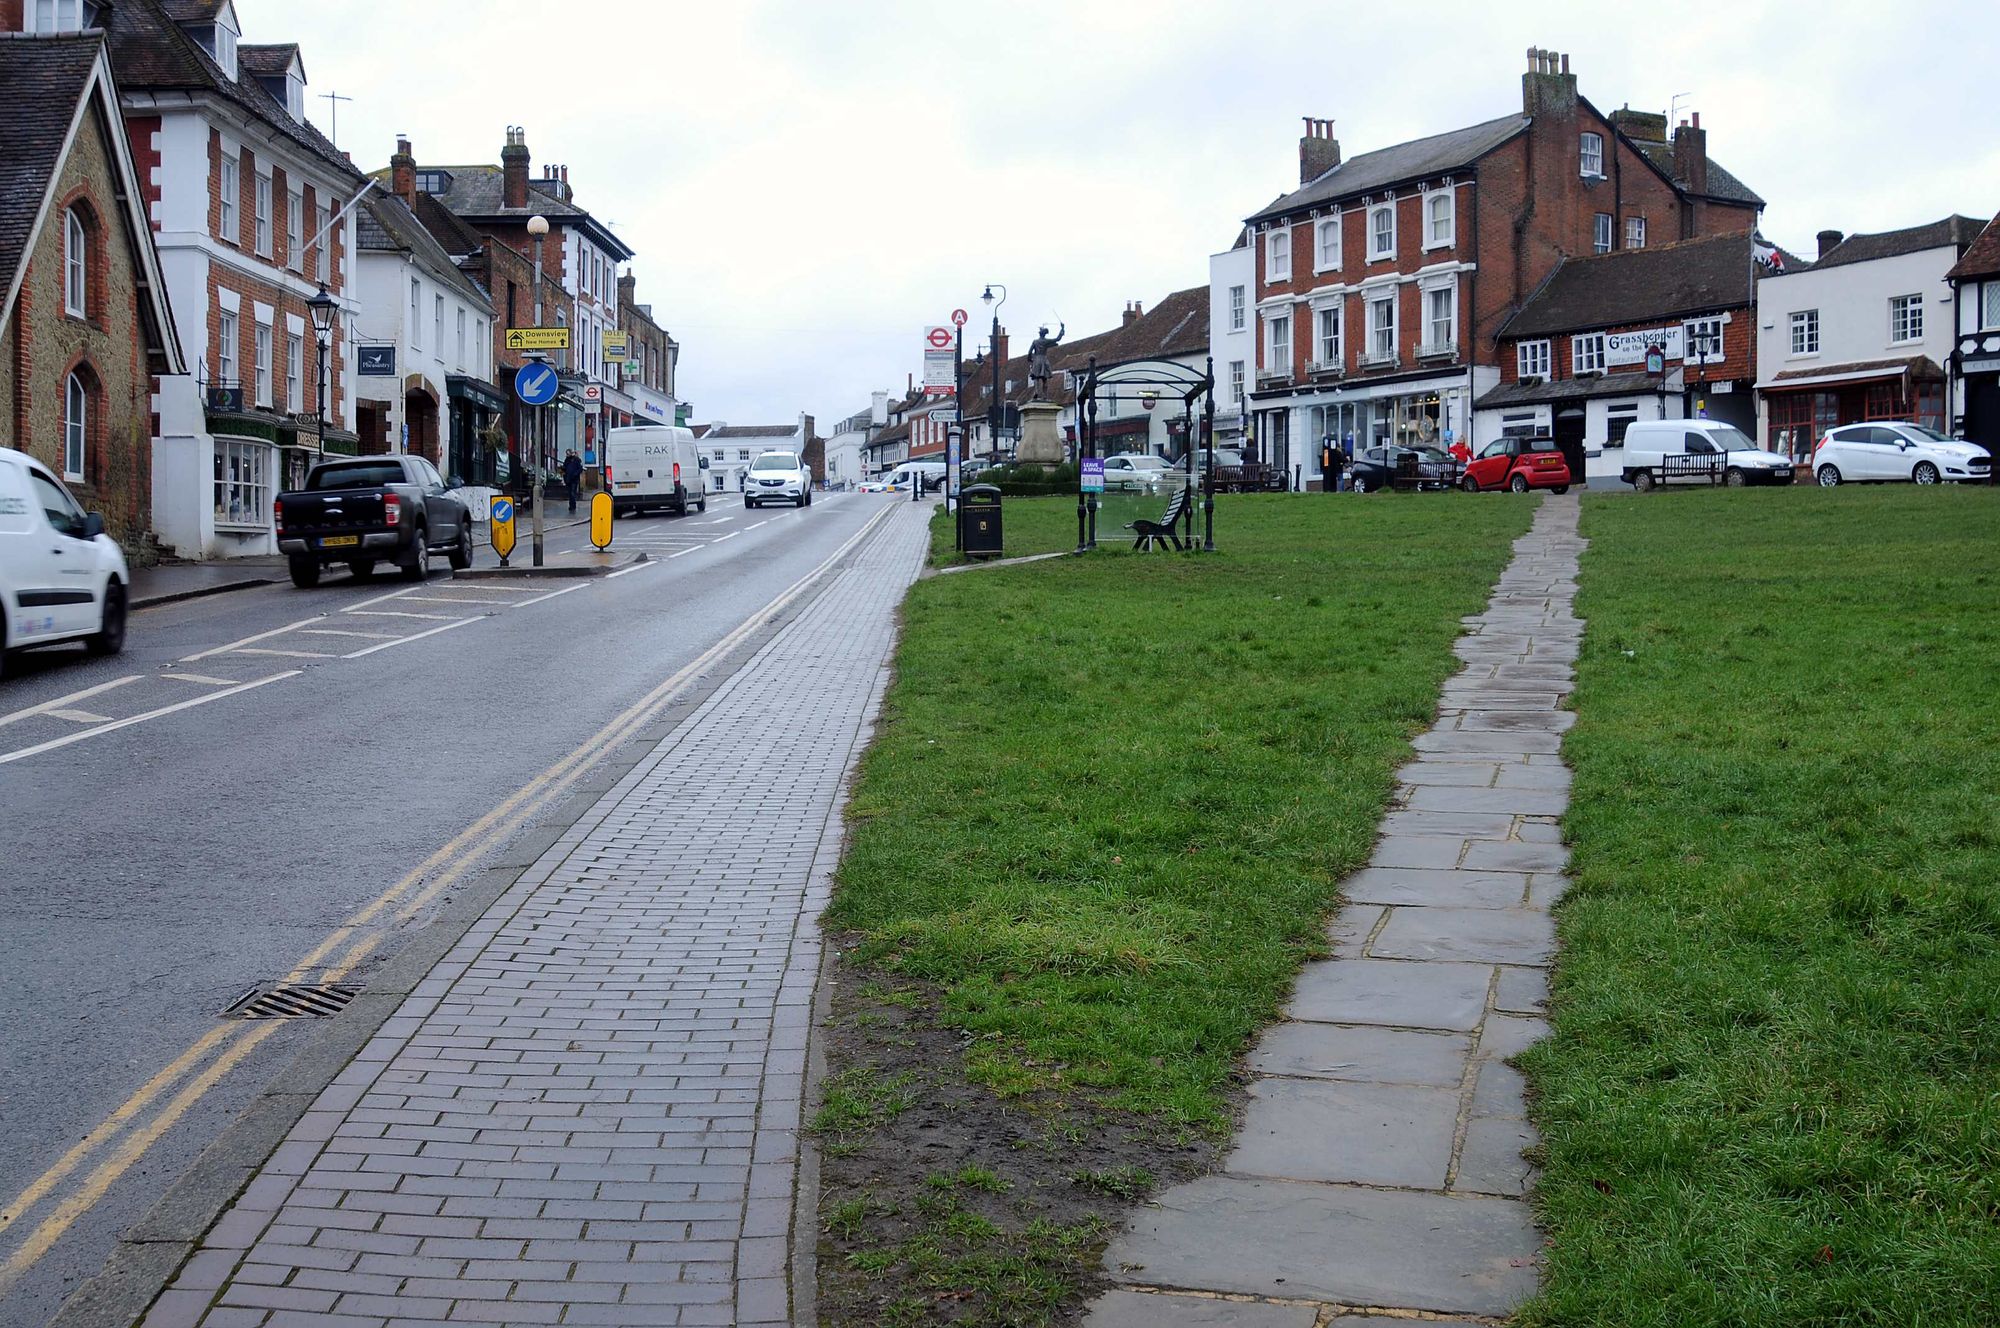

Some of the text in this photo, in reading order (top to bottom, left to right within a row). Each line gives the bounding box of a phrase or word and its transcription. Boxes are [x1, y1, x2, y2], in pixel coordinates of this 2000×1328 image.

[954, 310, 965, 323] A
[525, 330, 567, 338] Downsview
[1609, 330, 1678, 350] Grasshopper
[644, 445, 669, 455] RAK
[287, 518, 383, 530] RANGER
